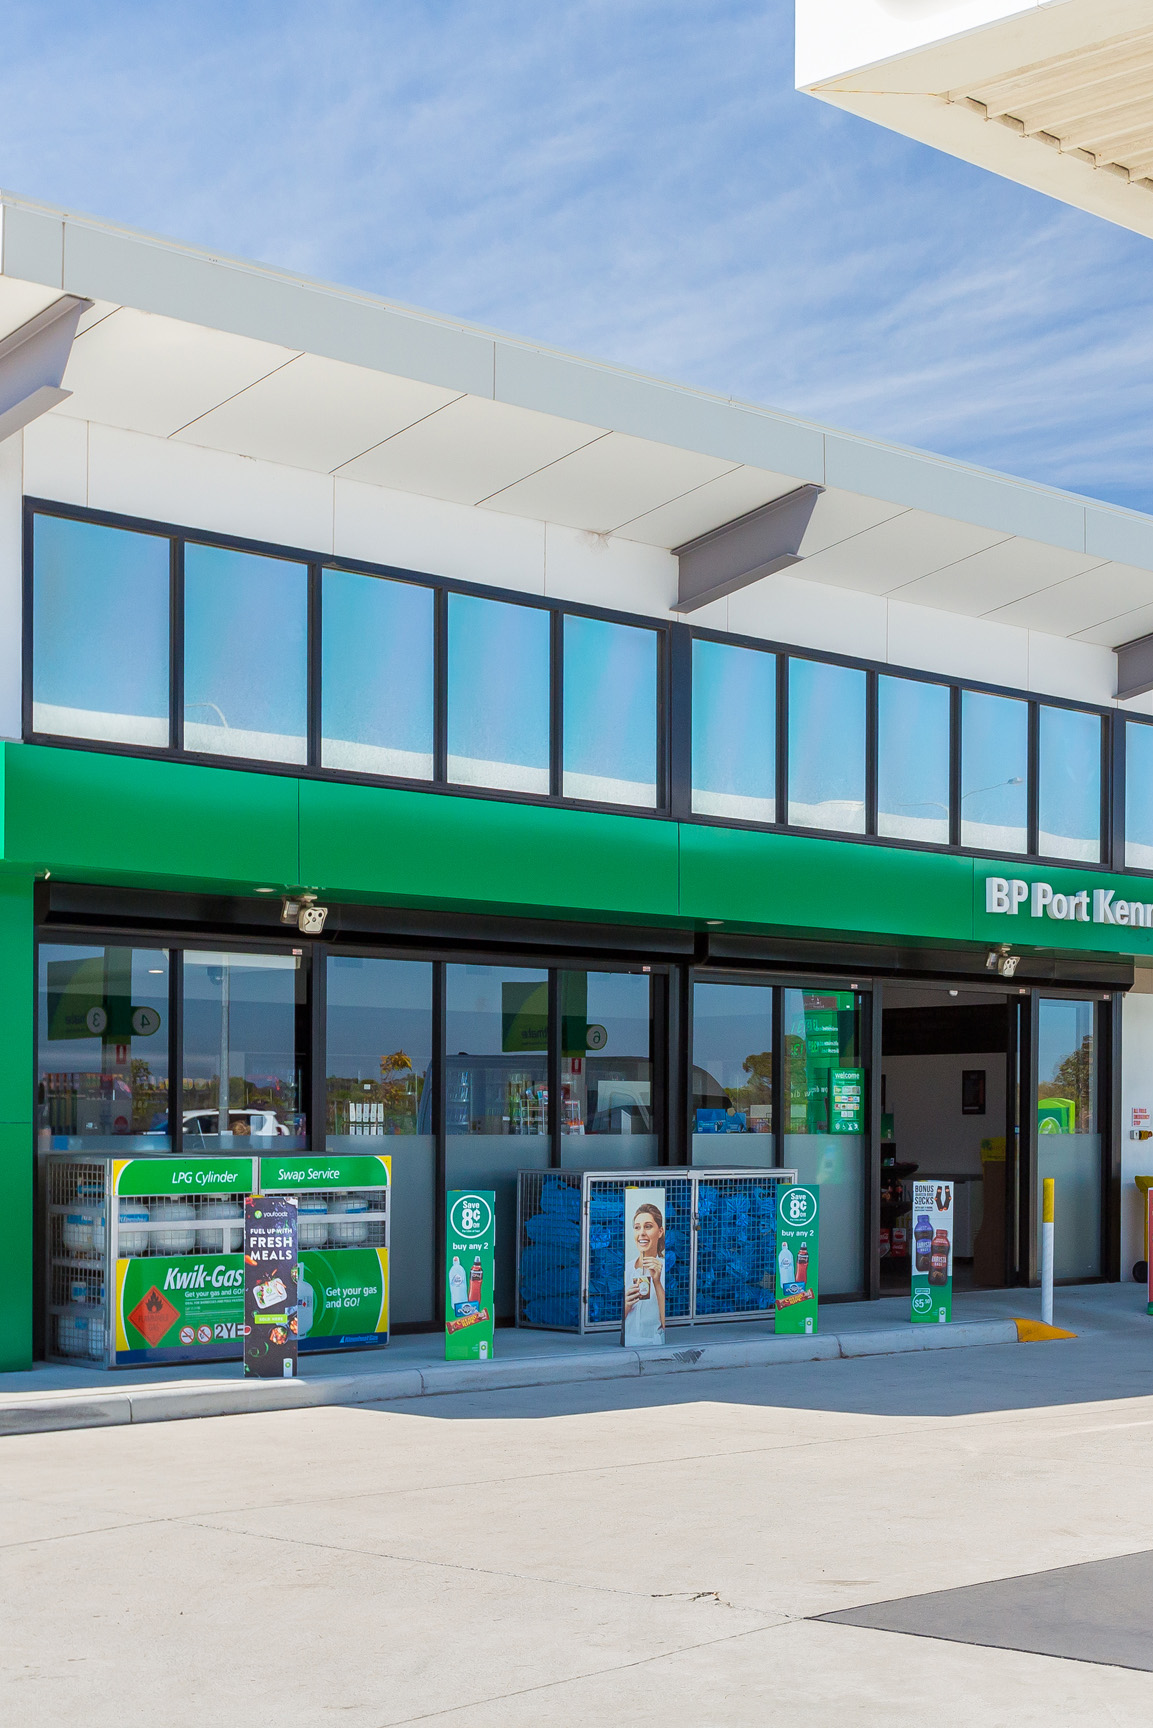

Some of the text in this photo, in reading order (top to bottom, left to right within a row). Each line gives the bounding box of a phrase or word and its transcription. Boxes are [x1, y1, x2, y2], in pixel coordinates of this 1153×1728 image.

[985, 877, 1029, 915] BP
[1031, 882, 1090, 922] Port
[835, 1072, 860, 1080] welcome
[172, 1171, 238, 1186] LPG Cylinder
[277, 1168, 340, 1182] Swap Service
[790, 1192, 806, 1200] Save
[914, 1197, 934, 1205] SOCKS
[462, 1200, 480, 1209] Save
[781, 1230, 794, 1238] buy
[250, 1236, 292, 1248] FRESH
[452, 1242, 489, 1251] buy any 2
[250, 1250, 292, 1260] MEALS
[163, 1264, 244, 1290] Kwik-Gas
[196, 1291, 209, 1299] your
[210, 1290, 220, 1298] gas
[326, 1287, 378, 1300] Get your gas
[326, 1298, 360, 1309] and GO!
